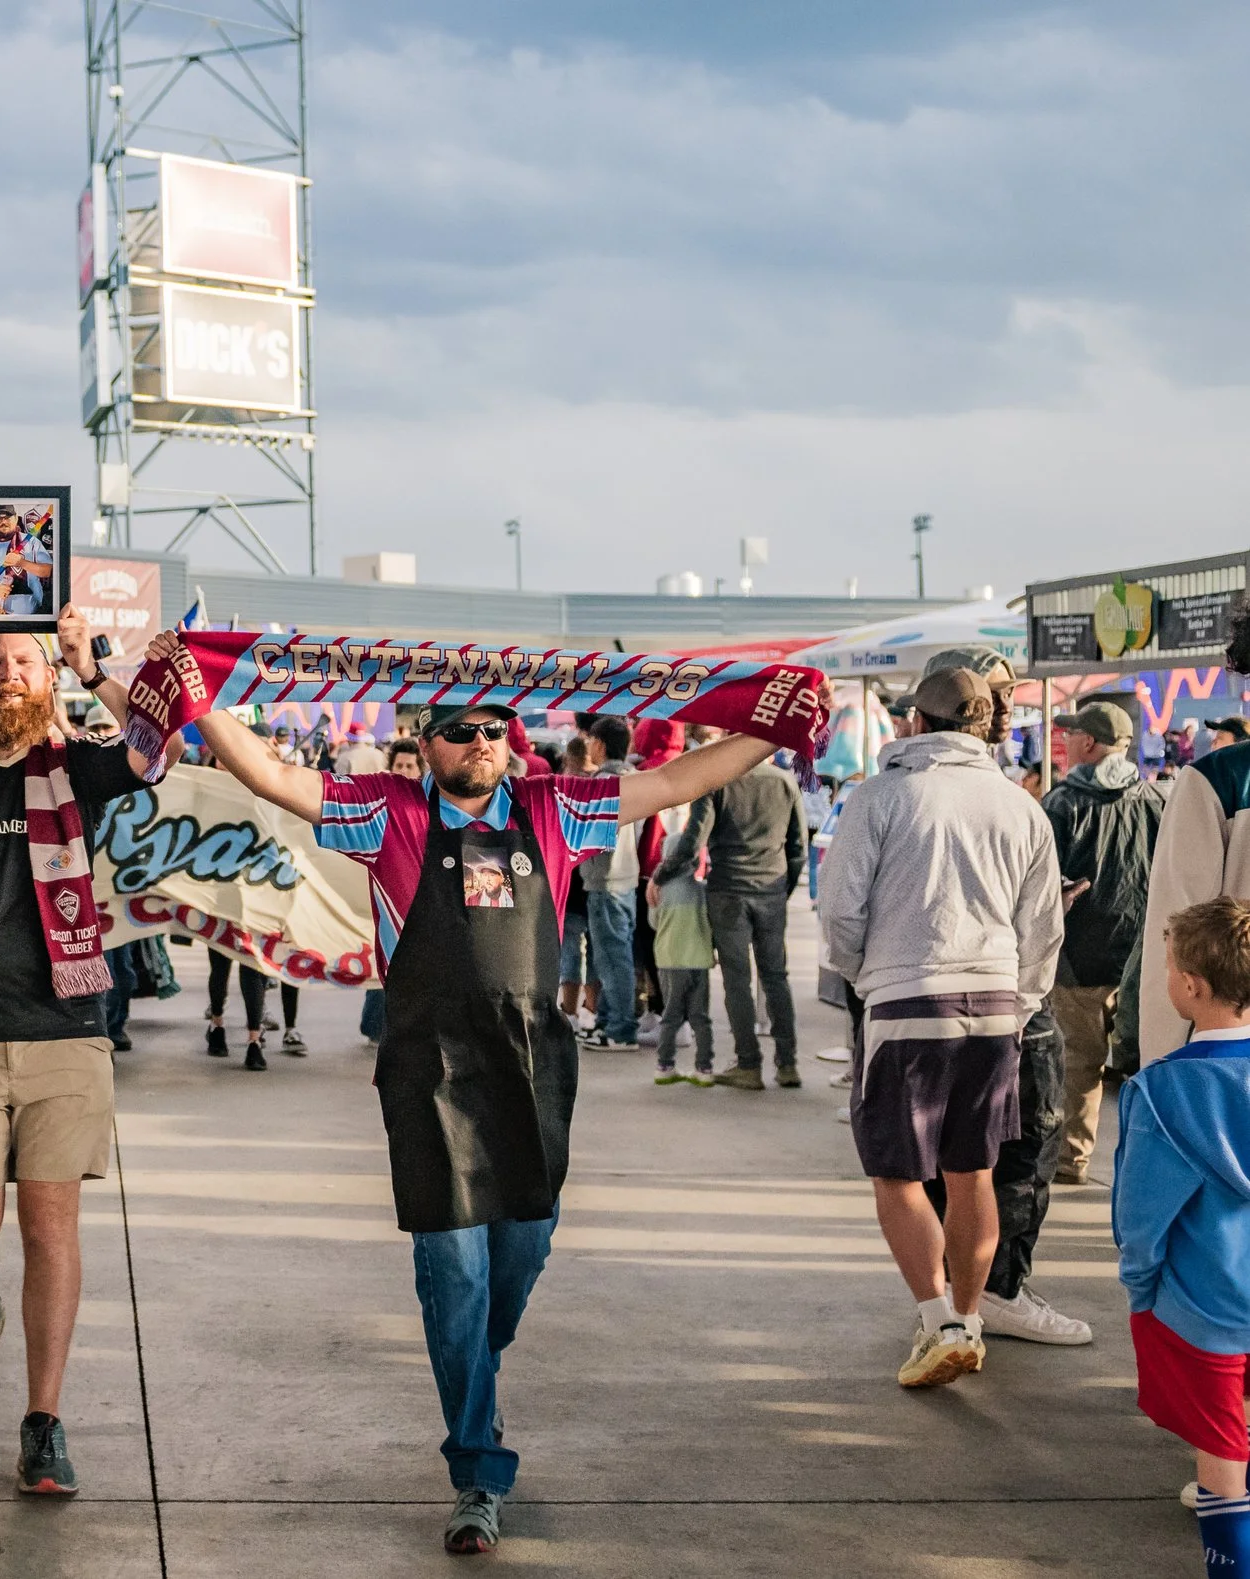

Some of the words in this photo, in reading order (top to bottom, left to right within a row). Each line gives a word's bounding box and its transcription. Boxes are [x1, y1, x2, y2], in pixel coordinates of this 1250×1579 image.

[173, 316, 290, 380] DICK'S
[115, 607, 151, 630] SHOP
[160, 668, 181, 706] TO
[168, 643, 208, 704] HERE
[252, 642, 611, 694] CENTENNIAL
[627, 661, 711, 701] 38
[750, 668, 805, 727] HERE
[130, 679, 169, 730] DRIN
[785, 687, 819, 720] TO
